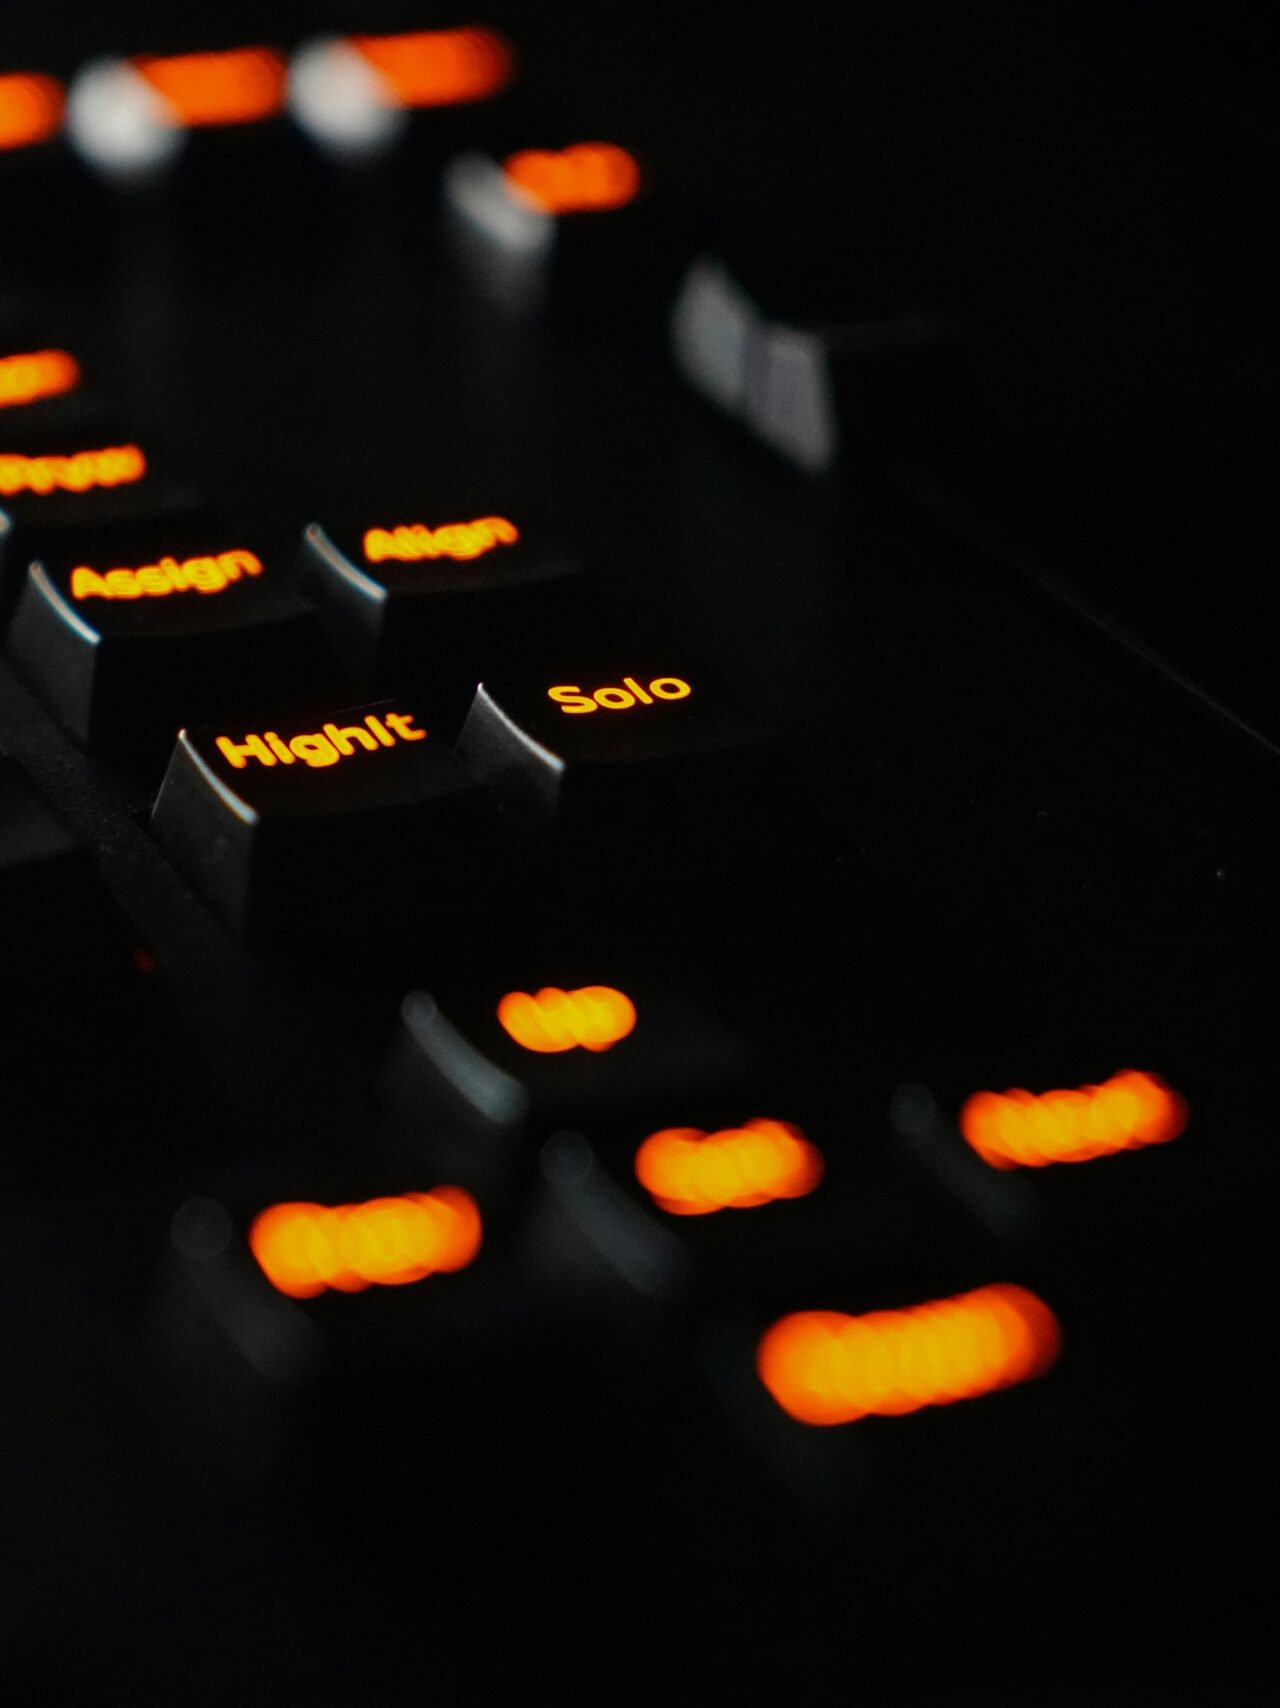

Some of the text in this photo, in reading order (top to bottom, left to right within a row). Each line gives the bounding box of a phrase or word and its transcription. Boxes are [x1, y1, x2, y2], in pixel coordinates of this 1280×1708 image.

[363, 516, 518, 562] Align
[70, 549, 263, 600] Assign
[547, 677, 691, 714] Solo
